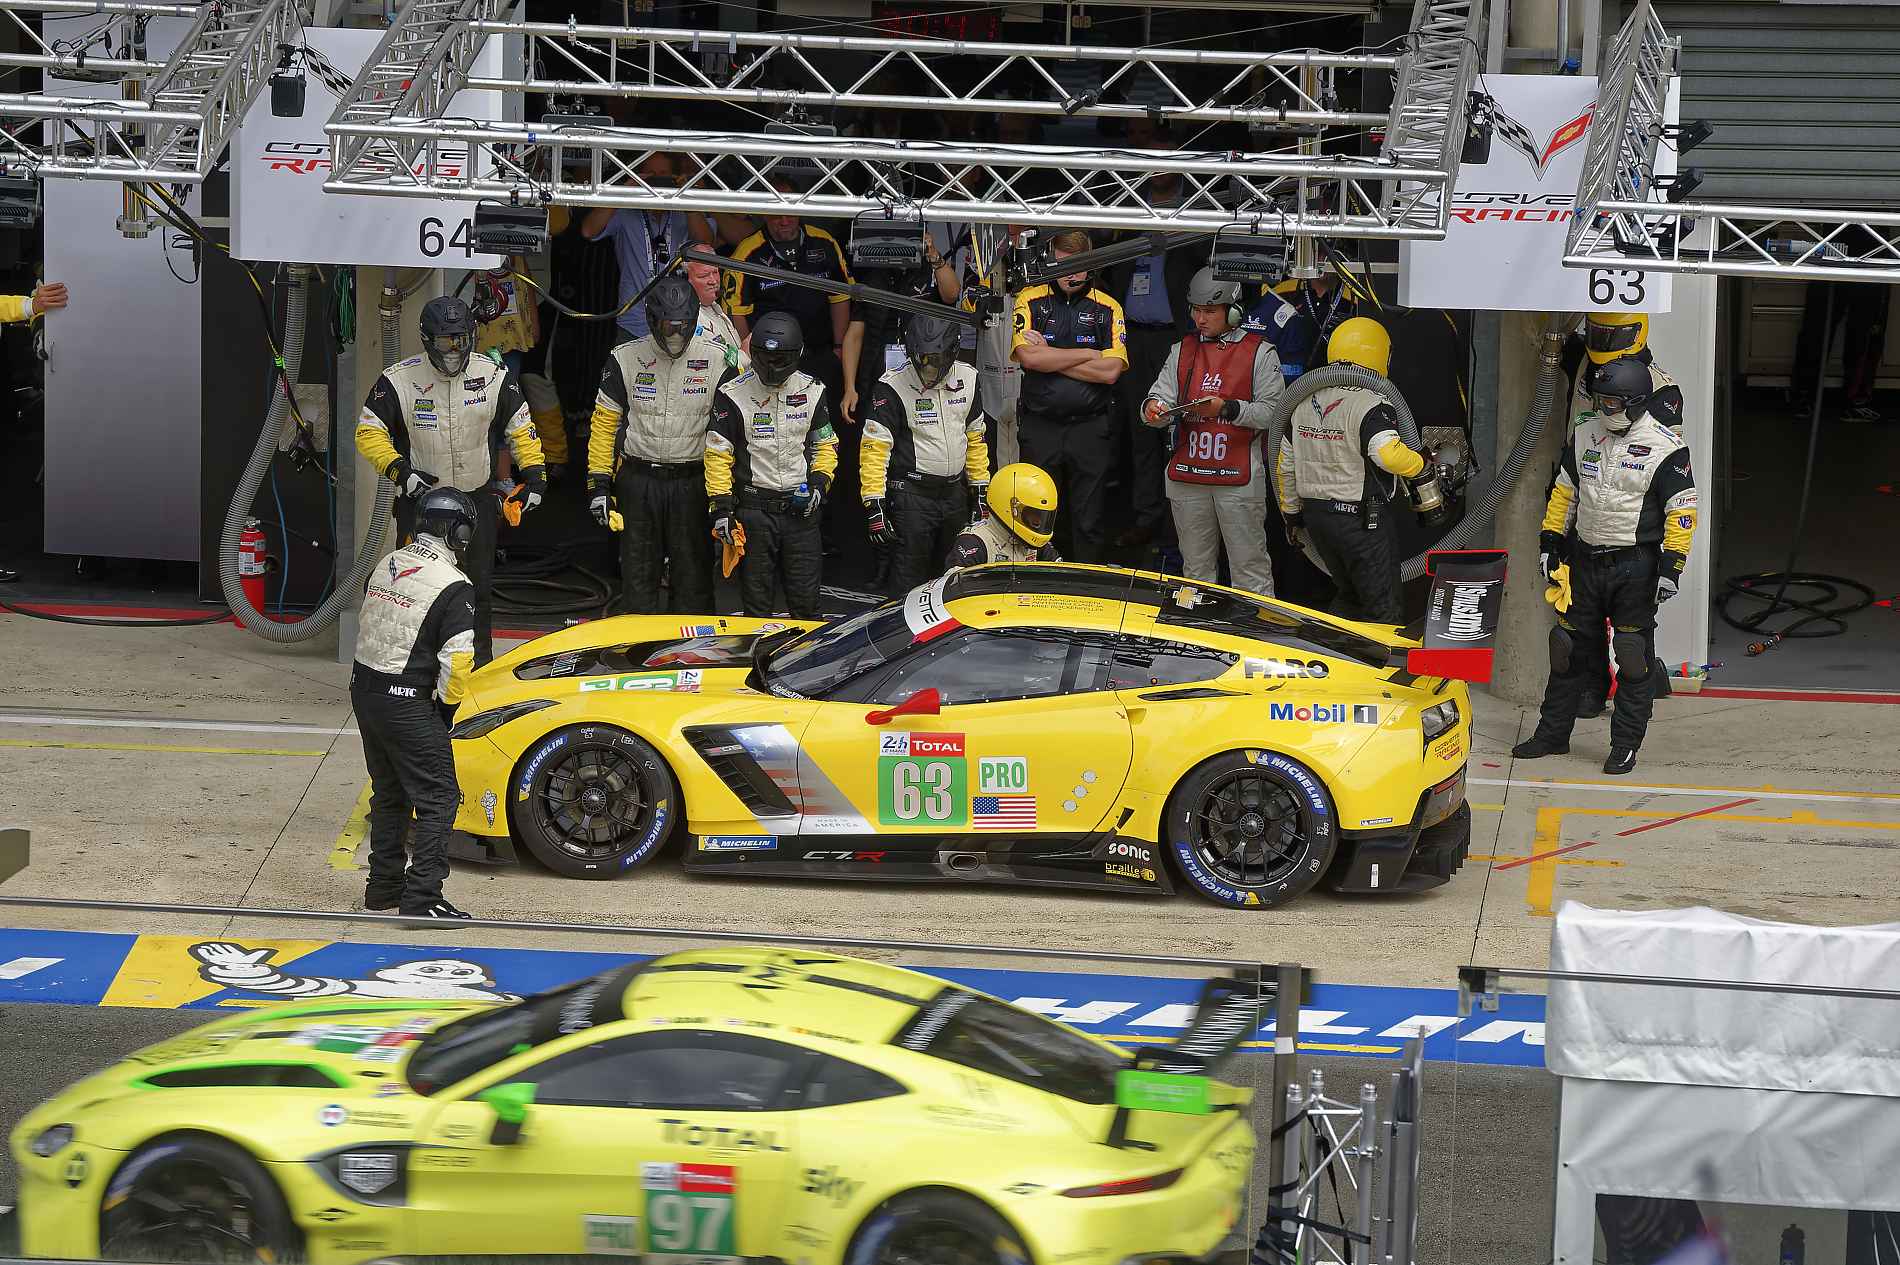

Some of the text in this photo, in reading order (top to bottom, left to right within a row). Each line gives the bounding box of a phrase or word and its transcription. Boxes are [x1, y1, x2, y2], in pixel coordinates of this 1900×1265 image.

[419, 216, 474, 258] 64
[1588, 268, 1645, 305] 63
[1188, 430, 1228, 461] 896
[1244, 658, 1330, 679] FARO
[1270, 703, 1346, 722] Mobil
[524, 737, 564, 782] MICHELIN
[912, 740, 963, 752] TOTAL
[892, 761, 953, 821] 63
[981, 761, 1025, 789] PRO
[1270, 756, 1325, 811] MICHELIN
[625, 819, 665, 865] MICHELIN
[720, 839, 771, 847] MICHELIN
[1105, 862, 1140, 876] braille
[1181, 847, 1234, 900] MICHELIN
[656, 1118, 790, 1152] TOTAL
[802, 1167, 866, 1209] sky
[651, 1194, 732, 1250] 97
